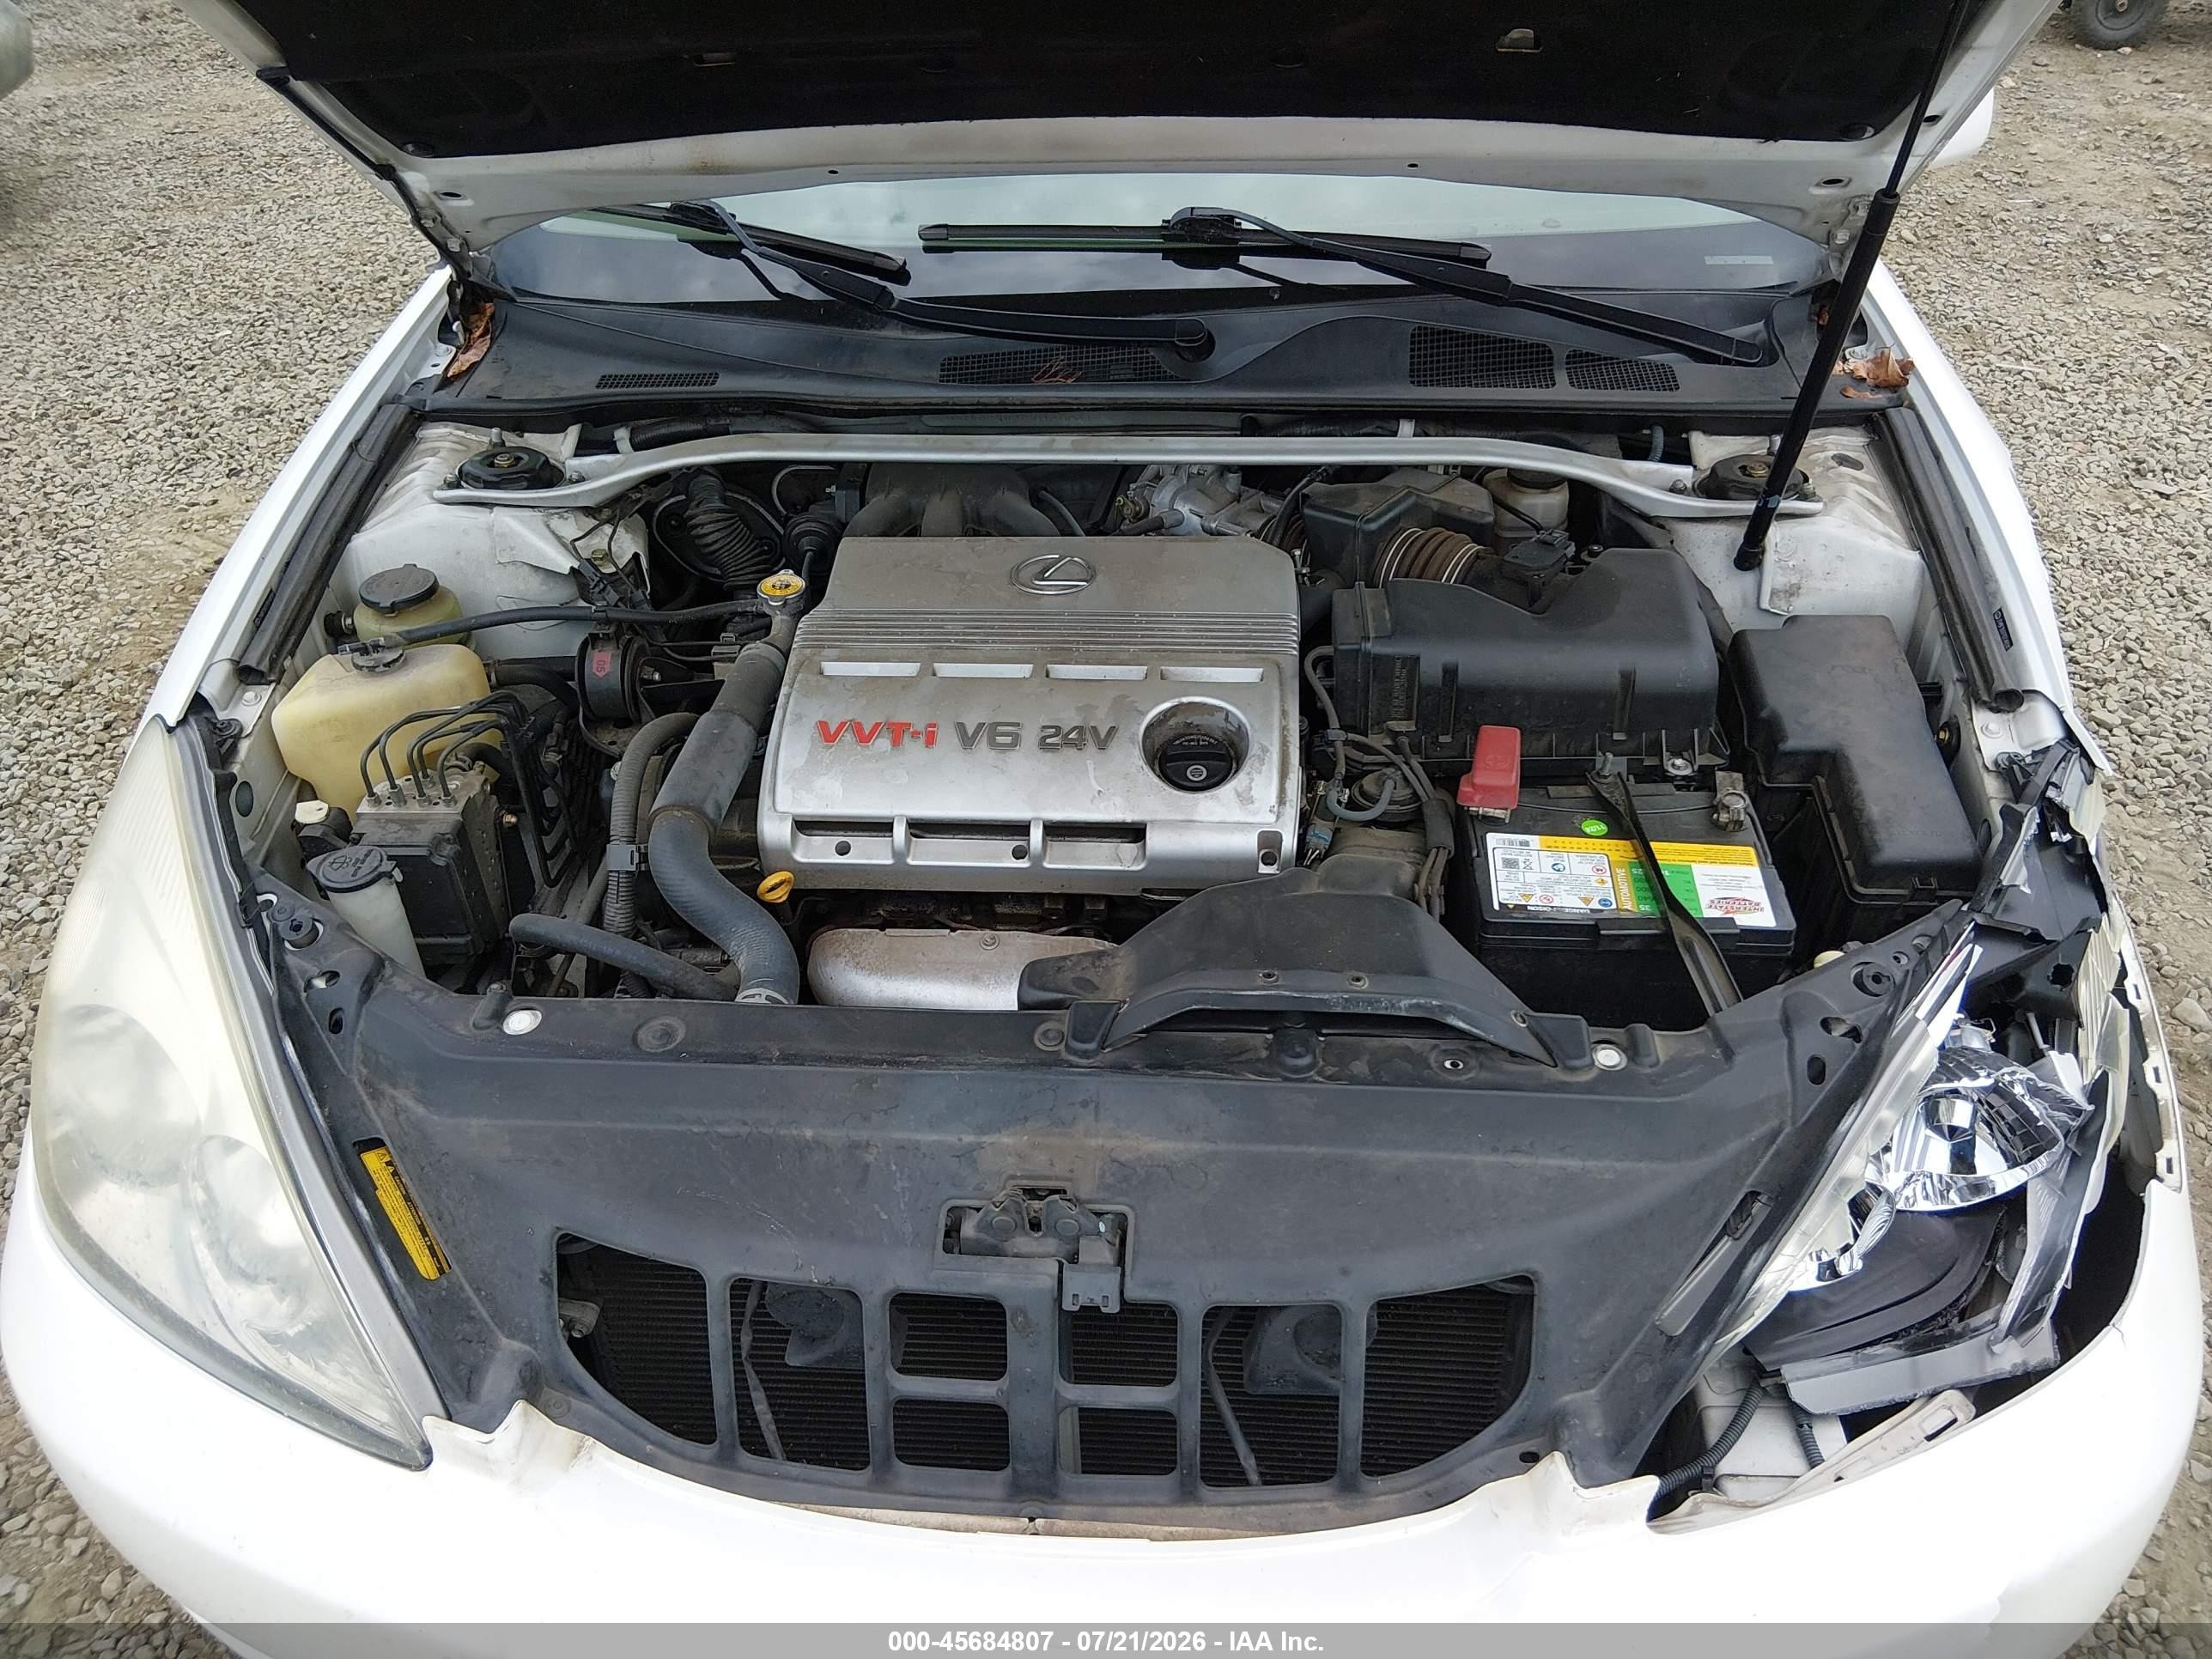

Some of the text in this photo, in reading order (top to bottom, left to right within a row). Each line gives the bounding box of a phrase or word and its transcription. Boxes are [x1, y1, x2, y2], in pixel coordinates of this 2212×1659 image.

[815, 720, 1119, 750] VVT-i V6 24V
[1615, 867, 1633, 911] AUTOMOTIVE
[1707, 903, 1765, 913] INTERSTATE
